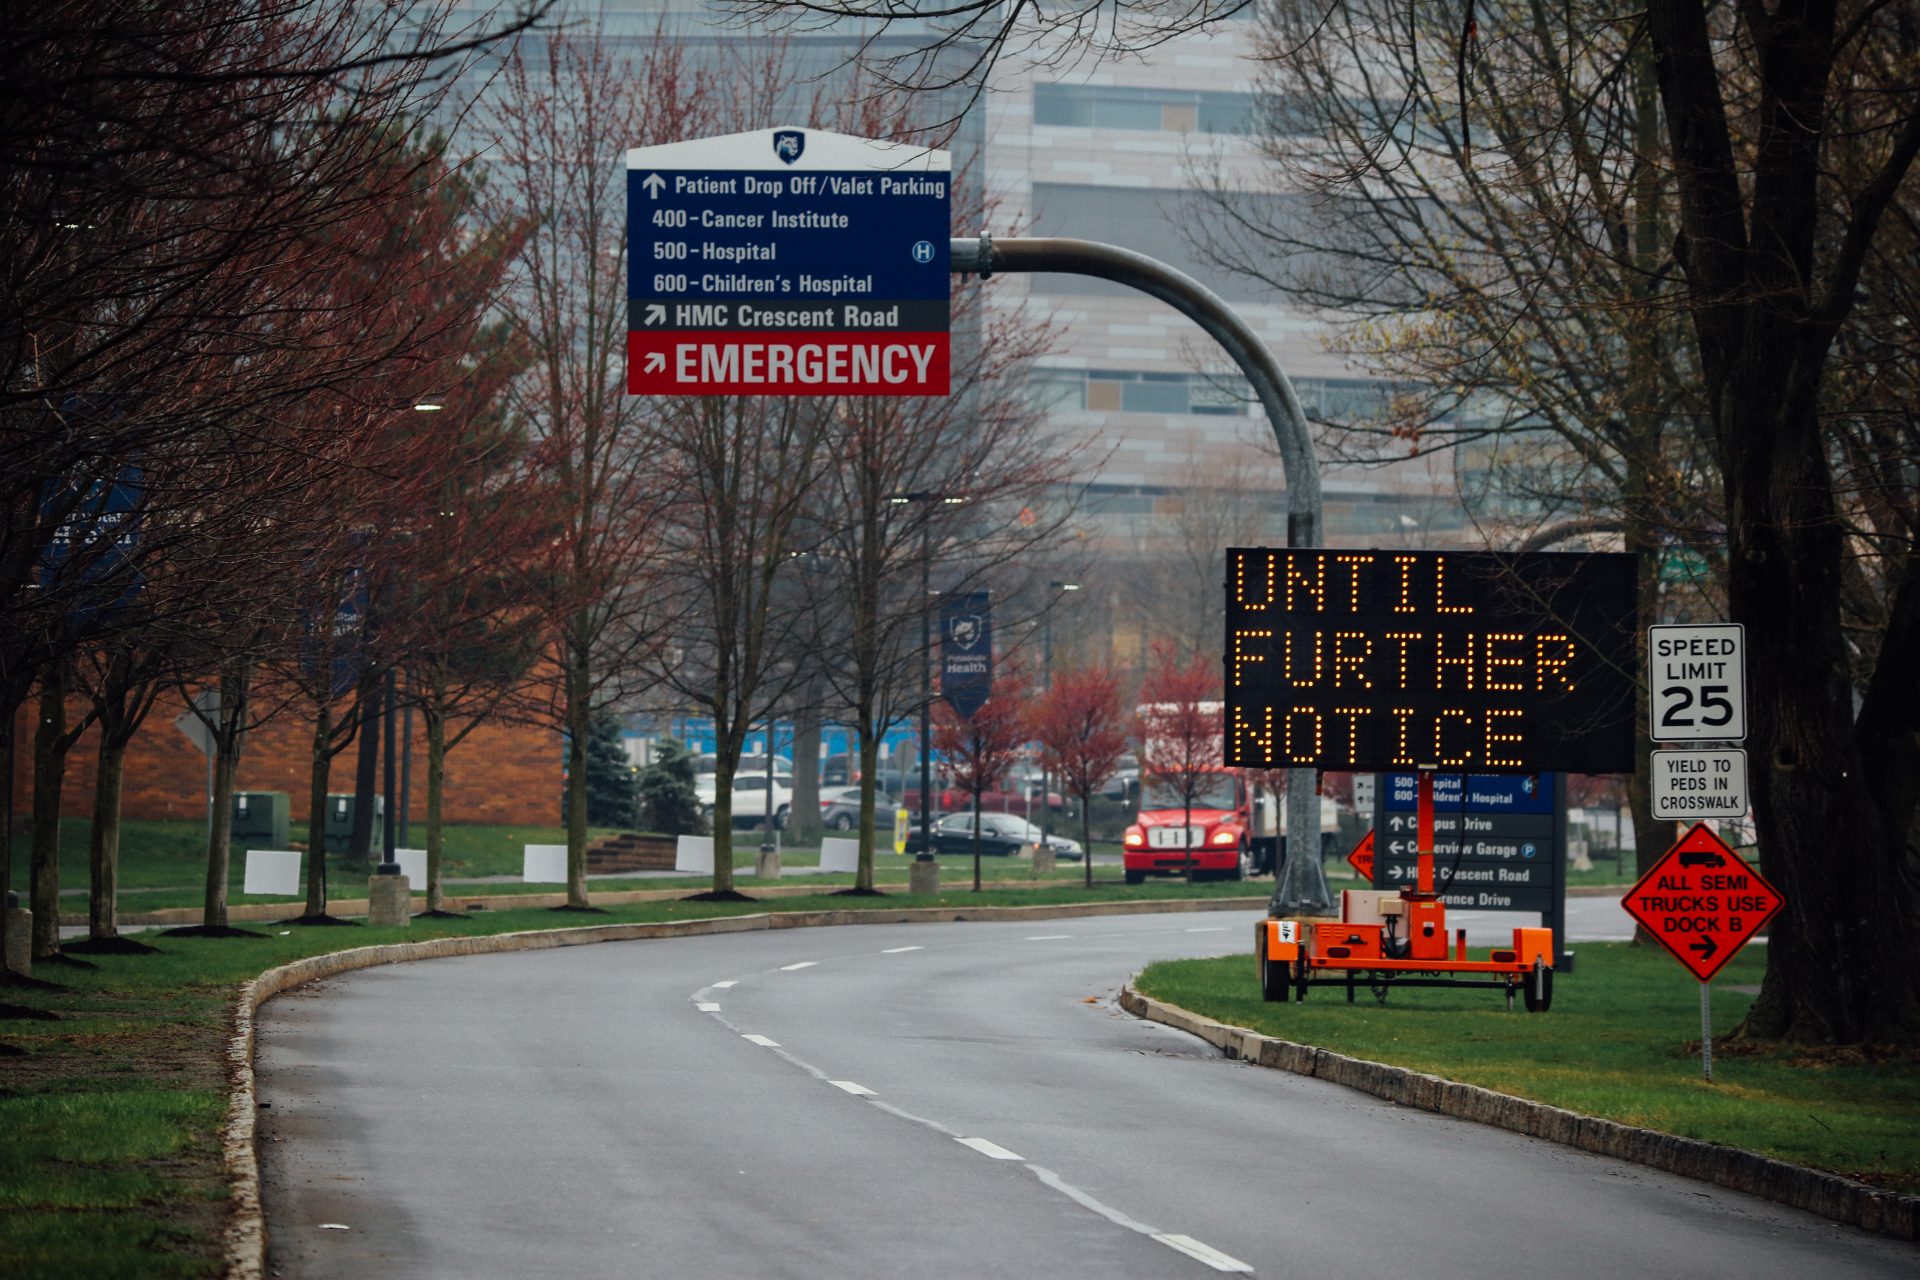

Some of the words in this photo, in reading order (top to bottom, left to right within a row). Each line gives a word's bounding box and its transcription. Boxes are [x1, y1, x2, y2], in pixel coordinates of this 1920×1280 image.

[675, 176, 737, 195] Patient
[744, 176, 783, 198] Drop
[880, 177, 945, 199] Parking
[772, 210, 849, 228] Institute
[799, 275, 872, 296] Hospital
[675, 305, 728, 327] HMC
[738, 305, 834, 327] Crescent
[844, 305, 899, 327] Road
[675, 343, 936, 384] EMERGENCY
[1236, 553, 1475, 614] UNTIL
[1657, 637, 1735, 657] SPEED
[947, 661, 987, 673] Health
[1234, 630, 1576, 691] FURTHER
[1666, 662, 1727, 680] LIMIT
[1661, 685, 1734, 727] 25
[1234, 705, 1524, 767] NOTICE
[1667, 759, 1707, 773] YIELD
[1713, 759, 1731, 773] TO
[1671, 777, 1707, 790] PEDS
[1714, 777, 1728, 790] IN
[1472, 793, 1513, 805] Hospital
[1660, 796, 1739, 810] CROSSWALK
[1407, 816, 1456, 832] Cpus
[1477, 842, 1517, 858] Garage
[1499, 868, 1530, 882] Road
[1657, 875, 1692, 891] ALL
[1701, 875, 1748, 891] SEMI
[1479, 892, 1511, 906] Drive
[1639, 896, 1719, 913] TRUCKS
[1727, 896, 1767, 912] USE
[1664, 917, 1720, 933] DOCK
[1729, 917, 1743, 932] B
